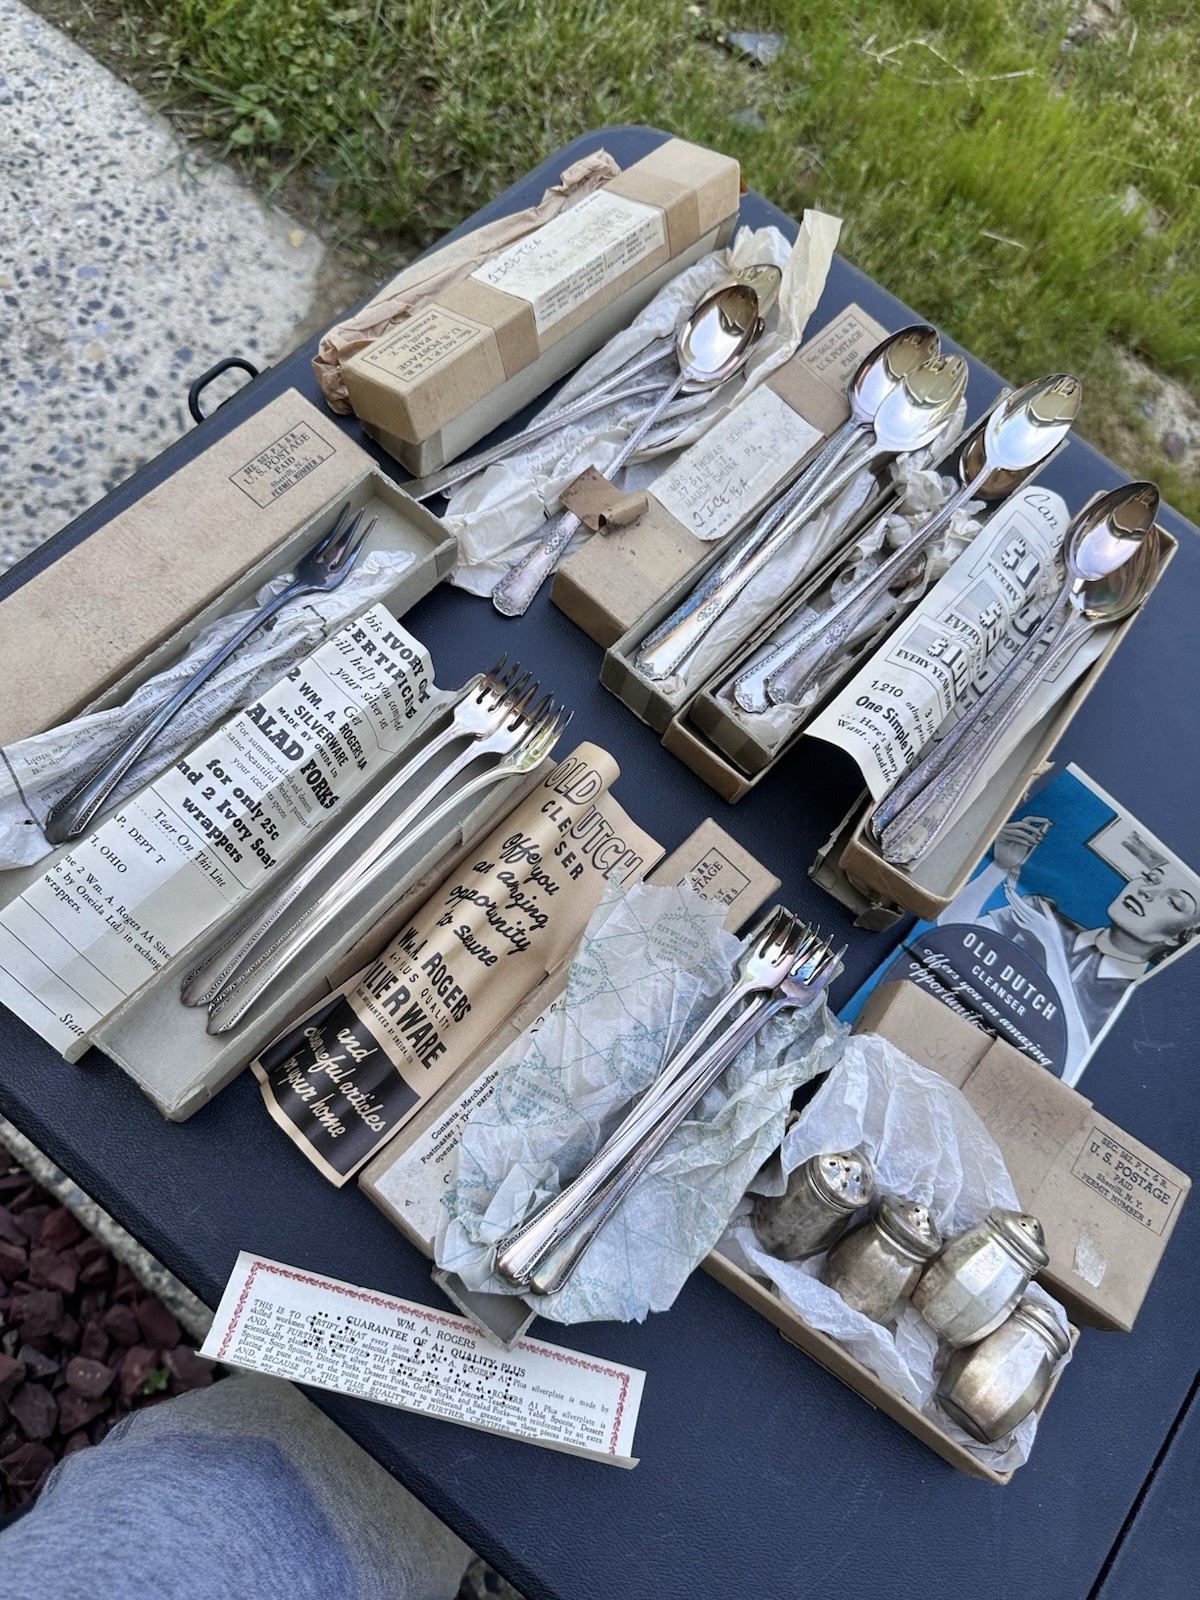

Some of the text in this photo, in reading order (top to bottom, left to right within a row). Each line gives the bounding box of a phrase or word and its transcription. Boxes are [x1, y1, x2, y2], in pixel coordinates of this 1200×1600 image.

[378, 314, 438, 355] Permit Number
[397, 340, 442, 371] POSTAGE
[408, 336, 431, 352] PAID
[830, 330, 863, 359] POSTAGE
[840, 349, 858, 367] PAID
[264, 432, 310, 469] POSTAGE
[274, 456, 295, 474] PAID
[692, 444, 724, 472] THOMAS
[271, 459, 318, 497] PERMIT NUMBER
[676, 486, 689, 498] 37
[690, 467, 714, 488] PINE
[684, 482, 712, 508] MAUCH
[712, 459, 739, 483] CHUNK
[743, 443, 762, 457] PA.
[1024, 493, 1058, 530] Can
[365, 611, 382, 632] his
[382, 631, 424, 677] IVORY
[896, 649, 932, 669] EVERY
[330, 668, 362, 691] your
[361, 693, 382, 716] silver
[345, 623, 417, 719] CERTIFICAE
[350, 657, 391, 699] help you
[286, 666, 363, 759] 2 WM. A. ROGERS
[344, 706, 363, 726] Get
[870, 679, 920, 722] 1,210 other
[235, 721, 276, 765] For summer
[277, 706, 332, 766] MADE BY ONEIDA
[294, 705, 348, 766] SILVERWARE
[855, 695, 908, 750] One Simple
[859, 717, 898, 772] Here's Money
[872, 743, 892, 783] Read the
[206, 759, 232, 785] for
[232, 787, 263, 821] only
[226, 732, 293, 807] same beautiful Berkeley
[230, 758, 250, 774] your
[250, 774, 268, 790] iced
[300, 759, 338, 809] FORKS
[544, 758, 602, 805] OLD
[182, 798, 242, 862] wrappers
[201, 786, 216, 800] 2
[216, 799, 252, 841] Ivory
[100, 846, 127, 873] OHIO
[128, 827, 166, 864] DEPT T
[154, 808, 225, 887] Tear On This Line
[541, 800, 584, 880] CLESER
[44, 875, 81, 913] wrappers.
[523, 866, 559, 895] you
[63, 872, 74, 885] by
[76, 885, 104, 915] Oneida
[105, 914, 125, 934] Ltd.)
[124, 932, 133, 943] in
[86, 873, 154, 943] Wm. A. Rogers AA
[436, 910, 453, 926] to
[670, 930, 699, 948] ONEIDA
[421, 952, 471, 1022] ROGERS
[963, 932, 1057, 1020] OLD DUTCH
[971, 965, 1027, 1017] CLEANSER
[60, 1013, 85, 1036] State
[362, 959, 448, 1069] ILVERWARE
[421, 988, 450, 1031] QUALITY
[924, 948, 960, 980] offers
[951, 981, 984, 1001] you
[982, 1001, 1000, 1017] an
[999, 1018, 1053, 1067] amazing
[337, 1028, 378, 1062] and
[278, 1071, 346, 1137] your home
[339, 1082, 386, 1132] articles
[431, 1071, 498, 1140] Contents Merchandise
[420, 1130, 454, 1164] Postmaster
[435, 1137, 458, 1163] opened
[1101, 1137, 1167, 1188] SEC. R.
[1090, 1141, 1170, 1204] U. S. POSTAGE
[1113, 1174, 1133, 1191] PAID
[1081, 1172, 1143, 1220] PERMIT NUMBER
[1124, 1193, 1133, 1203] N.
[1135, 1199, 1142, 1209] Y.
[238, 1338, 262, 1350] plating
[276, 1316, 388, 1354] workmen selected
[346, 1316, 408, 1341] GUARANTEE
[413, 1336, 428, 1346] OF
[397, 1317, 476, 1349] WM. A. ROGERS
[254, 1298, 609, 1413] THIS IS TO every piece Plus silverplate made by
[262, 1354, 299, 1370] BECAUSE
